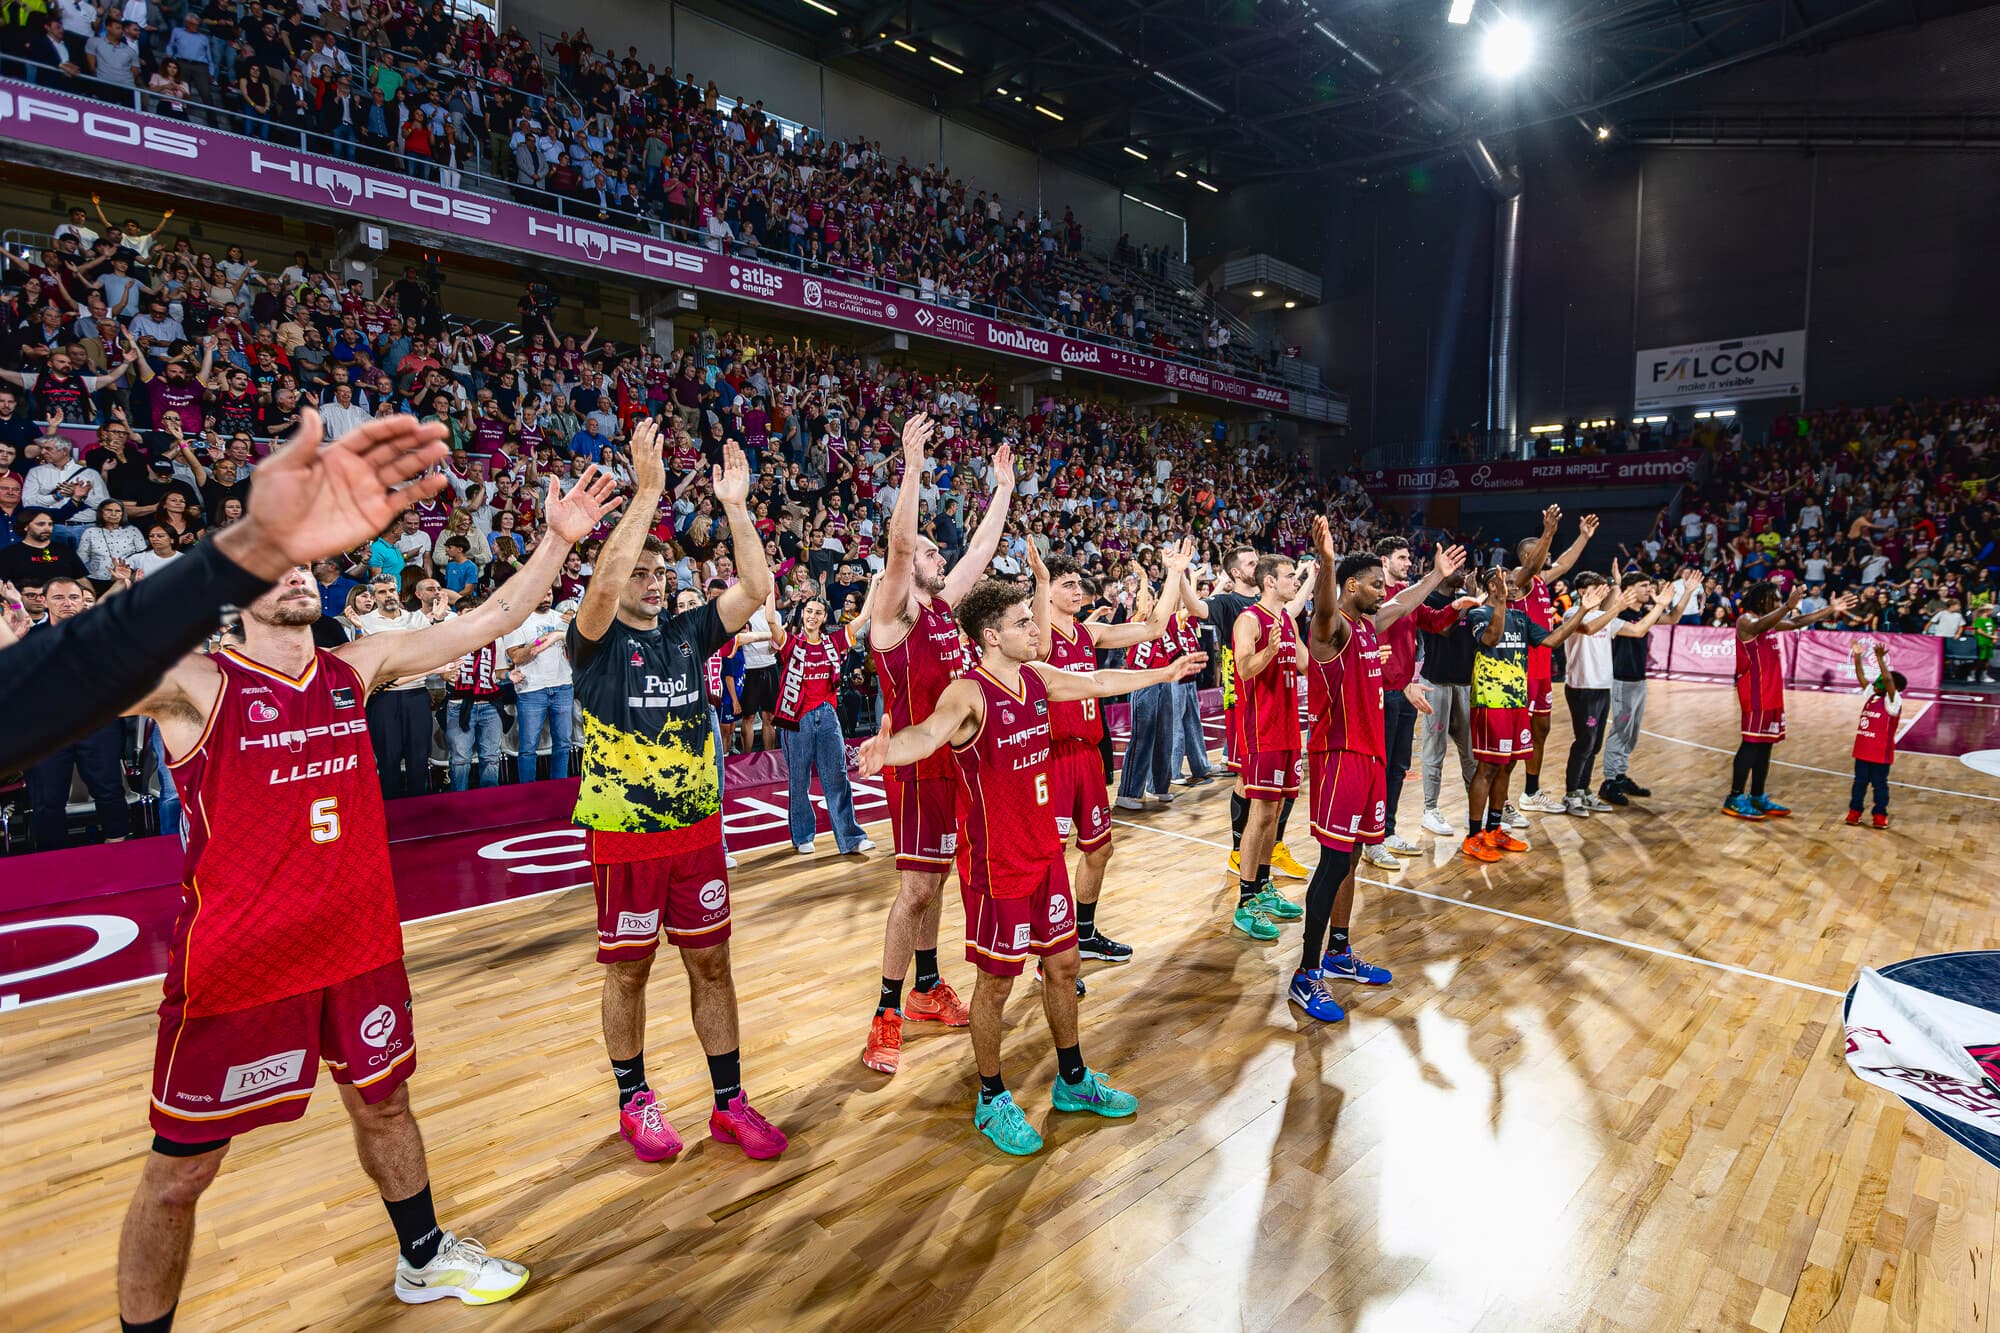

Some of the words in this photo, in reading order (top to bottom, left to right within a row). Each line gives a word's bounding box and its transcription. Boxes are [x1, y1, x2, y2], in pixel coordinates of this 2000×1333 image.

[0, 88, 198, 158] POS
[250, 150, 491, 224] HIOPOS
[528, 216, 704, 273] HIOPOS
[742, 268, 783, 289] atlas
[743, 284, 774, 297] energia
[824, 299, 838, 308] LES
[840, 303, 883, 318] GARRIGUES
[936, 315, 975, 335] semic
[1653, 347, 1785, 383] FALCON
[1255, 388, 1284, 402] DHL
[1677, 381, 1706, 392] make
[1708, 379, 1715, 389] it
[1718, 377, 1755, 388] visible
[1398, 469, 1437, 489] margi
[1532, 465, 1561, 477] PIZZA
[643, 673, 688, 697] Pujol
[1081, 697, 1096, 721] 13
[240, 719, 368, 752] HIOPOS
[269, 754, 358, 785] LLEIDA
[1034, 772, 1049, 806] 6
[310, 796, 342, 844] 5
[701, 885, 725, 903] Q2
[621, 917, 652, 929] PONS
[237, 1062, 288, 1089] PONS
